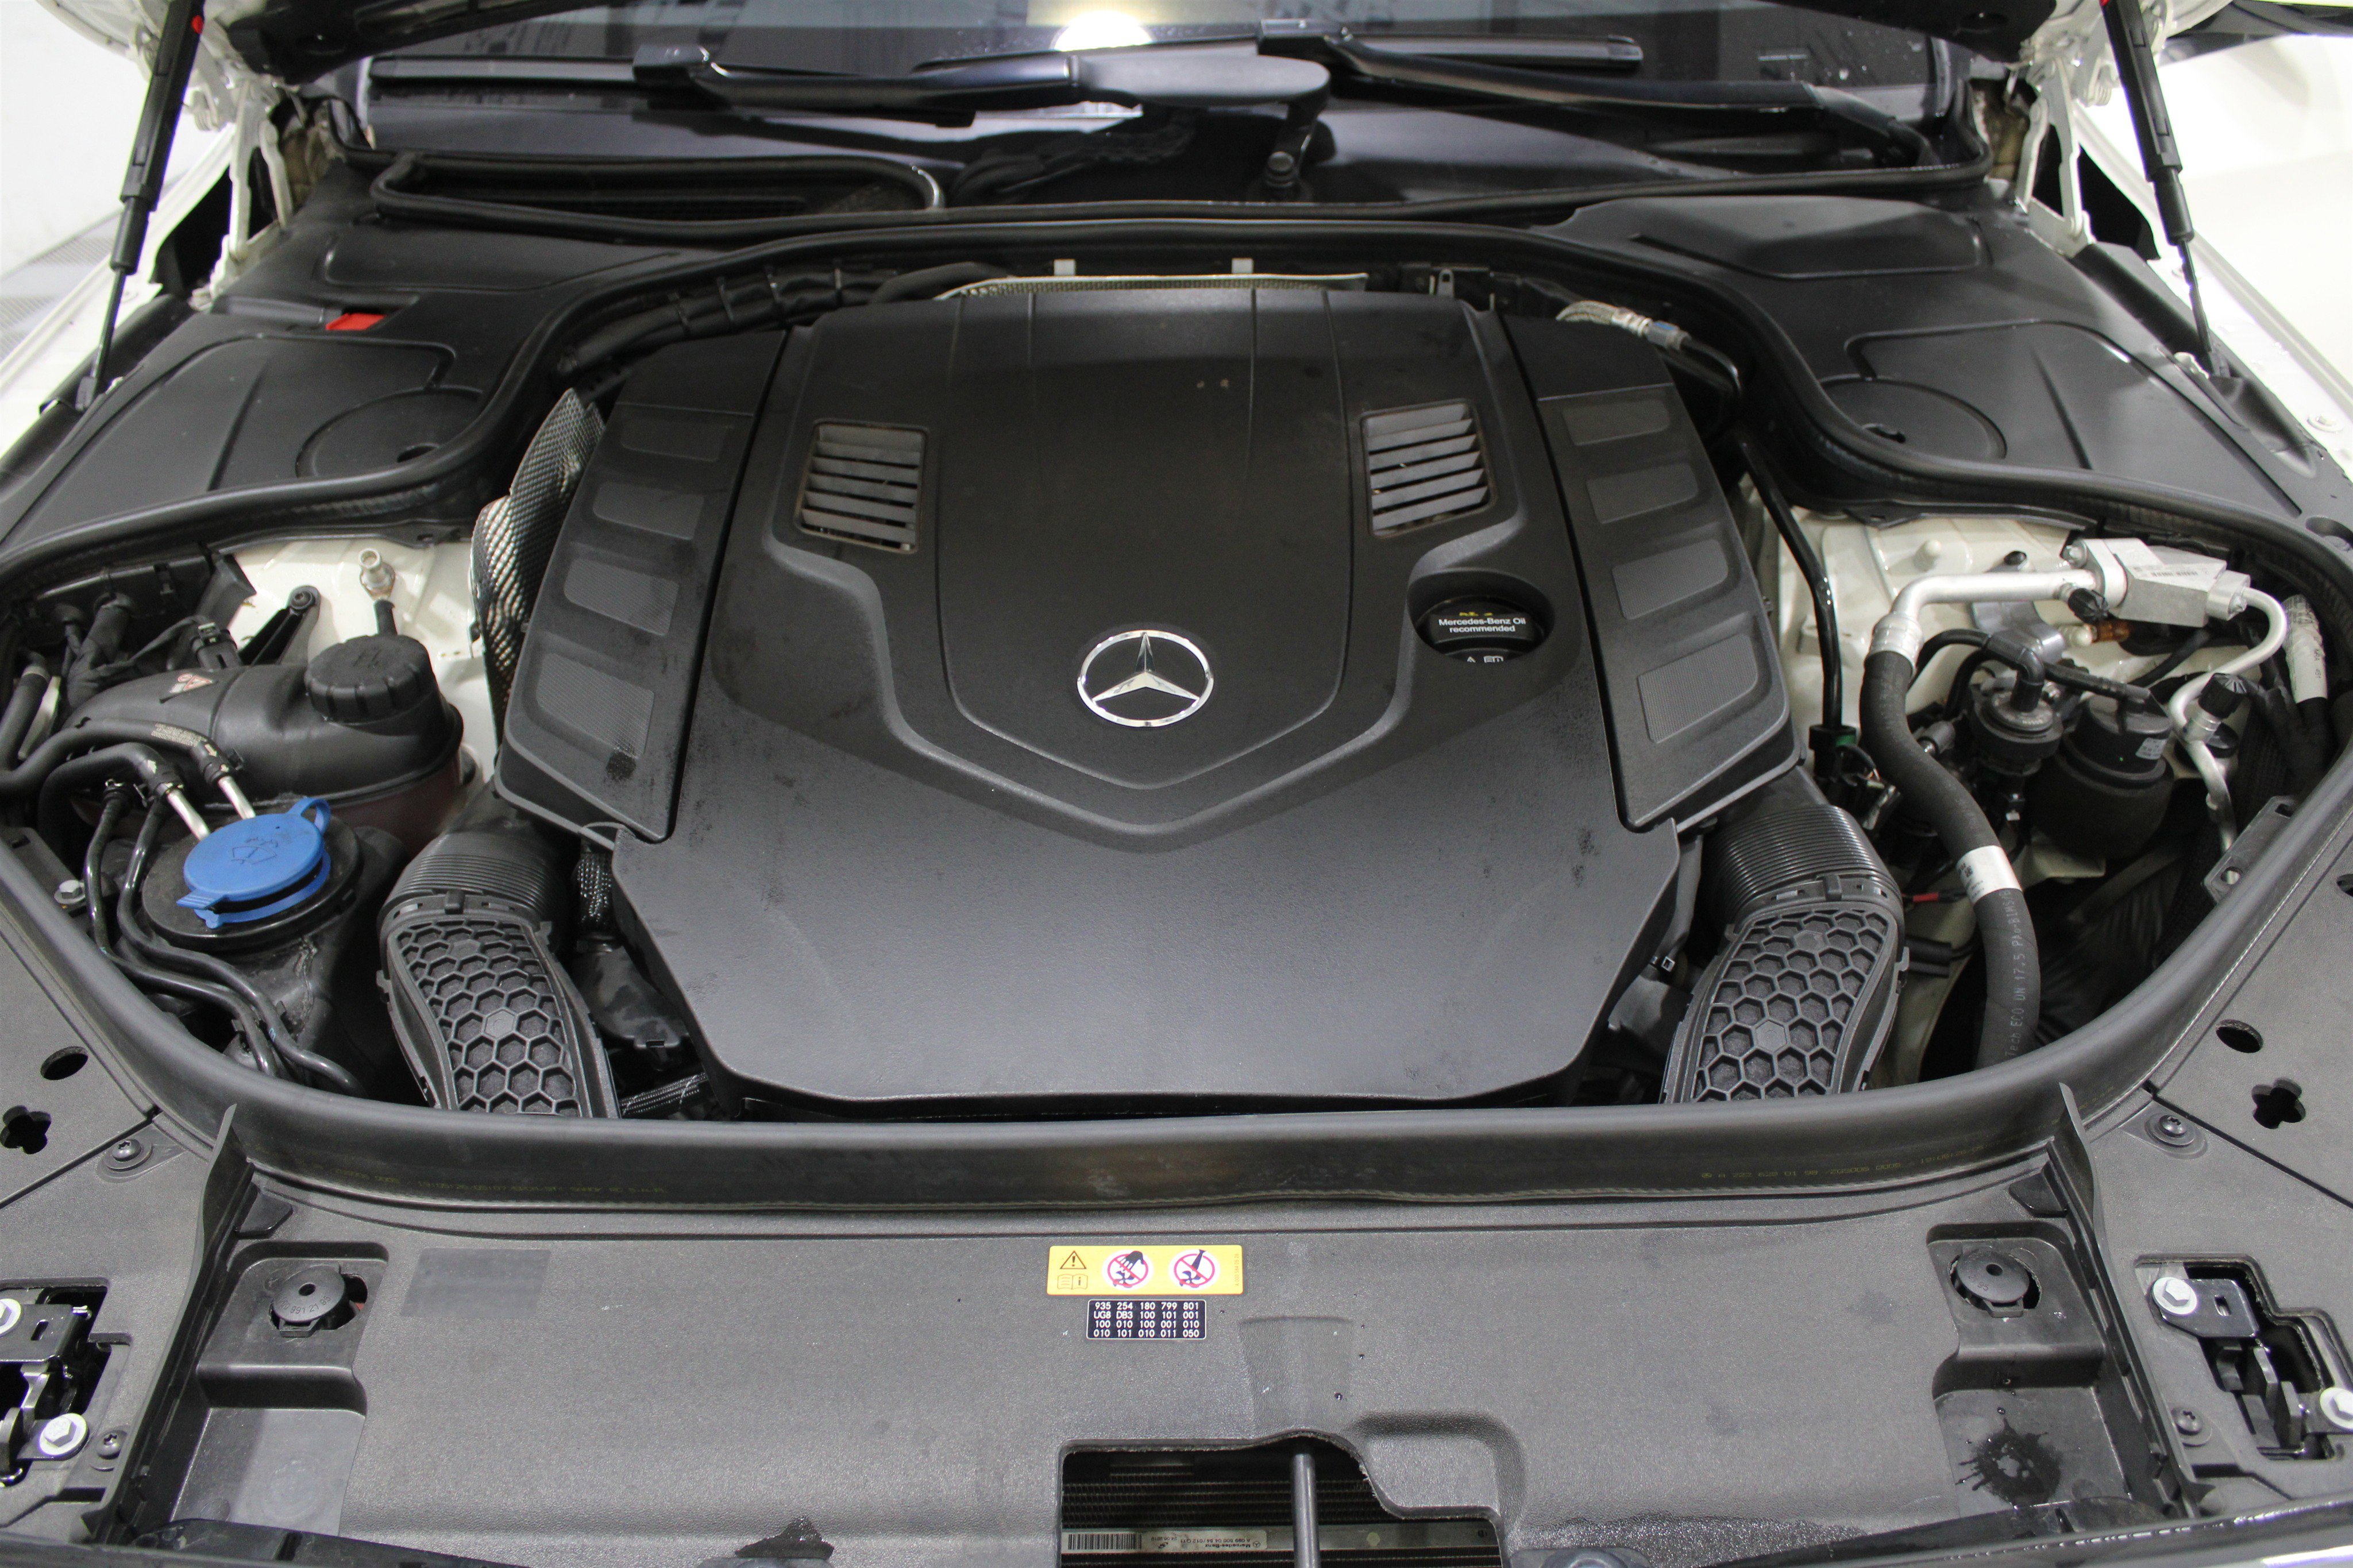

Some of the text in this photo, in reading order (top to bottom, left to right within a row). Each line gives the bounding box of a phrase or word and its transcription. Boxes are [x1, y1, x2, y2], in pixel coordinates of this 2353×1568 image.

[1438, 617, 1511, 626] Mercedes-Benz
[1449, 625, 1515, 633] recommended
[2013, 987, 2026, 1001] DN
[290, 1306, 305, 1314] 991
[308, 1303, 319, 1313] 21
[1095, 1302, 1198, 1310] 935 254 180 799 801
[1094, 1311, 1198, 1319] UG8 DB3 100 101 001
[1095, 1320, 1199, 1328] 100 010 100 001 010
[1093, 1330, 1199, 1338] 010 101 010 011 050
